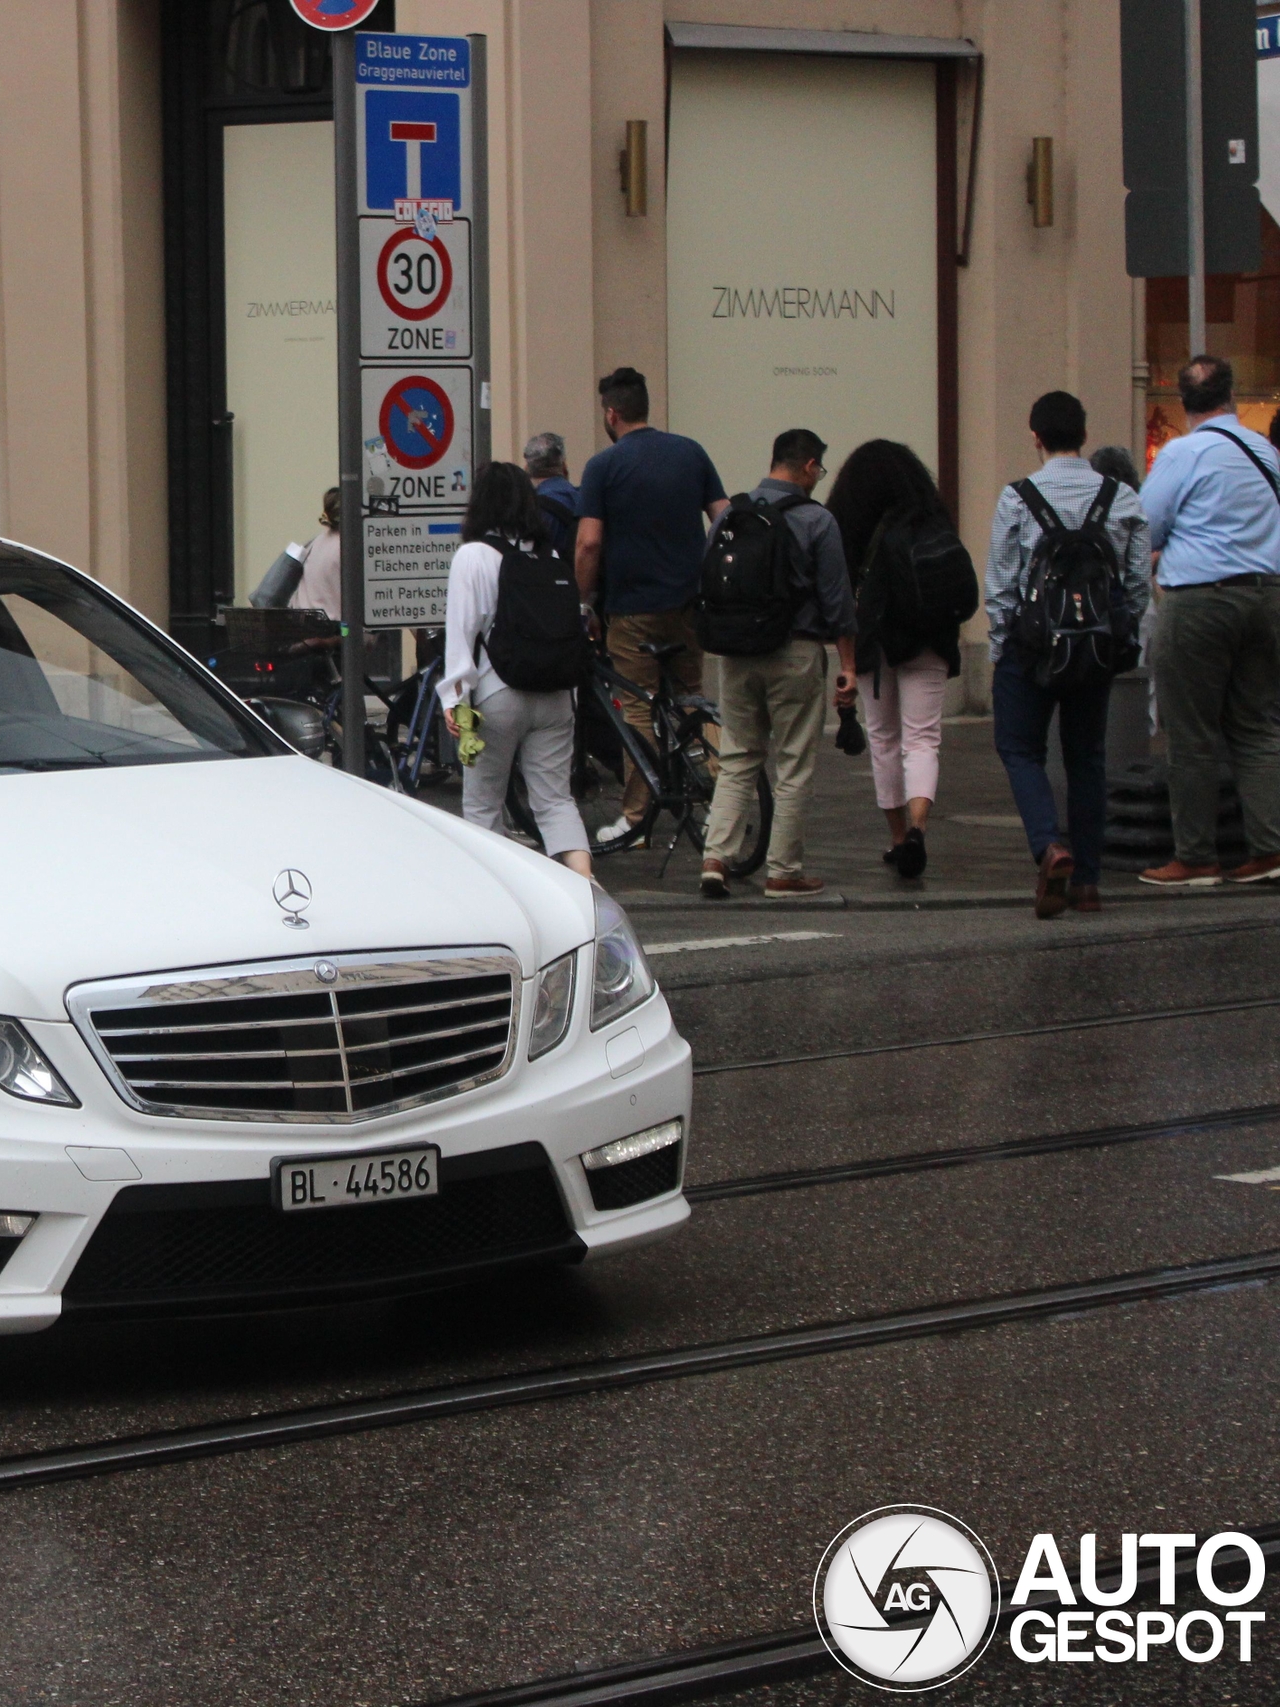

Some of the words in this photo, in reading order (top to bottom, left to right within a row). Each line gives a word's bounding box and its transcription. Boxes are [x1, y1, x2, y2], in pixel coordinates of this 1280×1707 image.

[366, 40, 412, 60] Blaue
[418, 42, 458, 62] Zone
[358, 62, 466, 82] Graggenauviertel
[393, 252, 437, 295] 30
[246, 300, 337, 318] ZIMMERMA
[712, 286, 896, 320] ZIMMERMANN
[387, 327, 444, 350] ZONE
[772, 366, 811, 376] OPENING
[812, 366, 838, 376] SOON
[389, 476, 446, 498] ZONE
[367, 525, 407, 537] Parken
[411, 524, 422, 536] in
[367, 541, 460, 558] gekennzeichnete
[374, 559, 419, 572] Flächen
[423, 558, 451, 571] erlau
[374, 588, 394, 600] mit
[398, 586, 448, 599] Parksche
[372, 604, 426, 619] werktags
